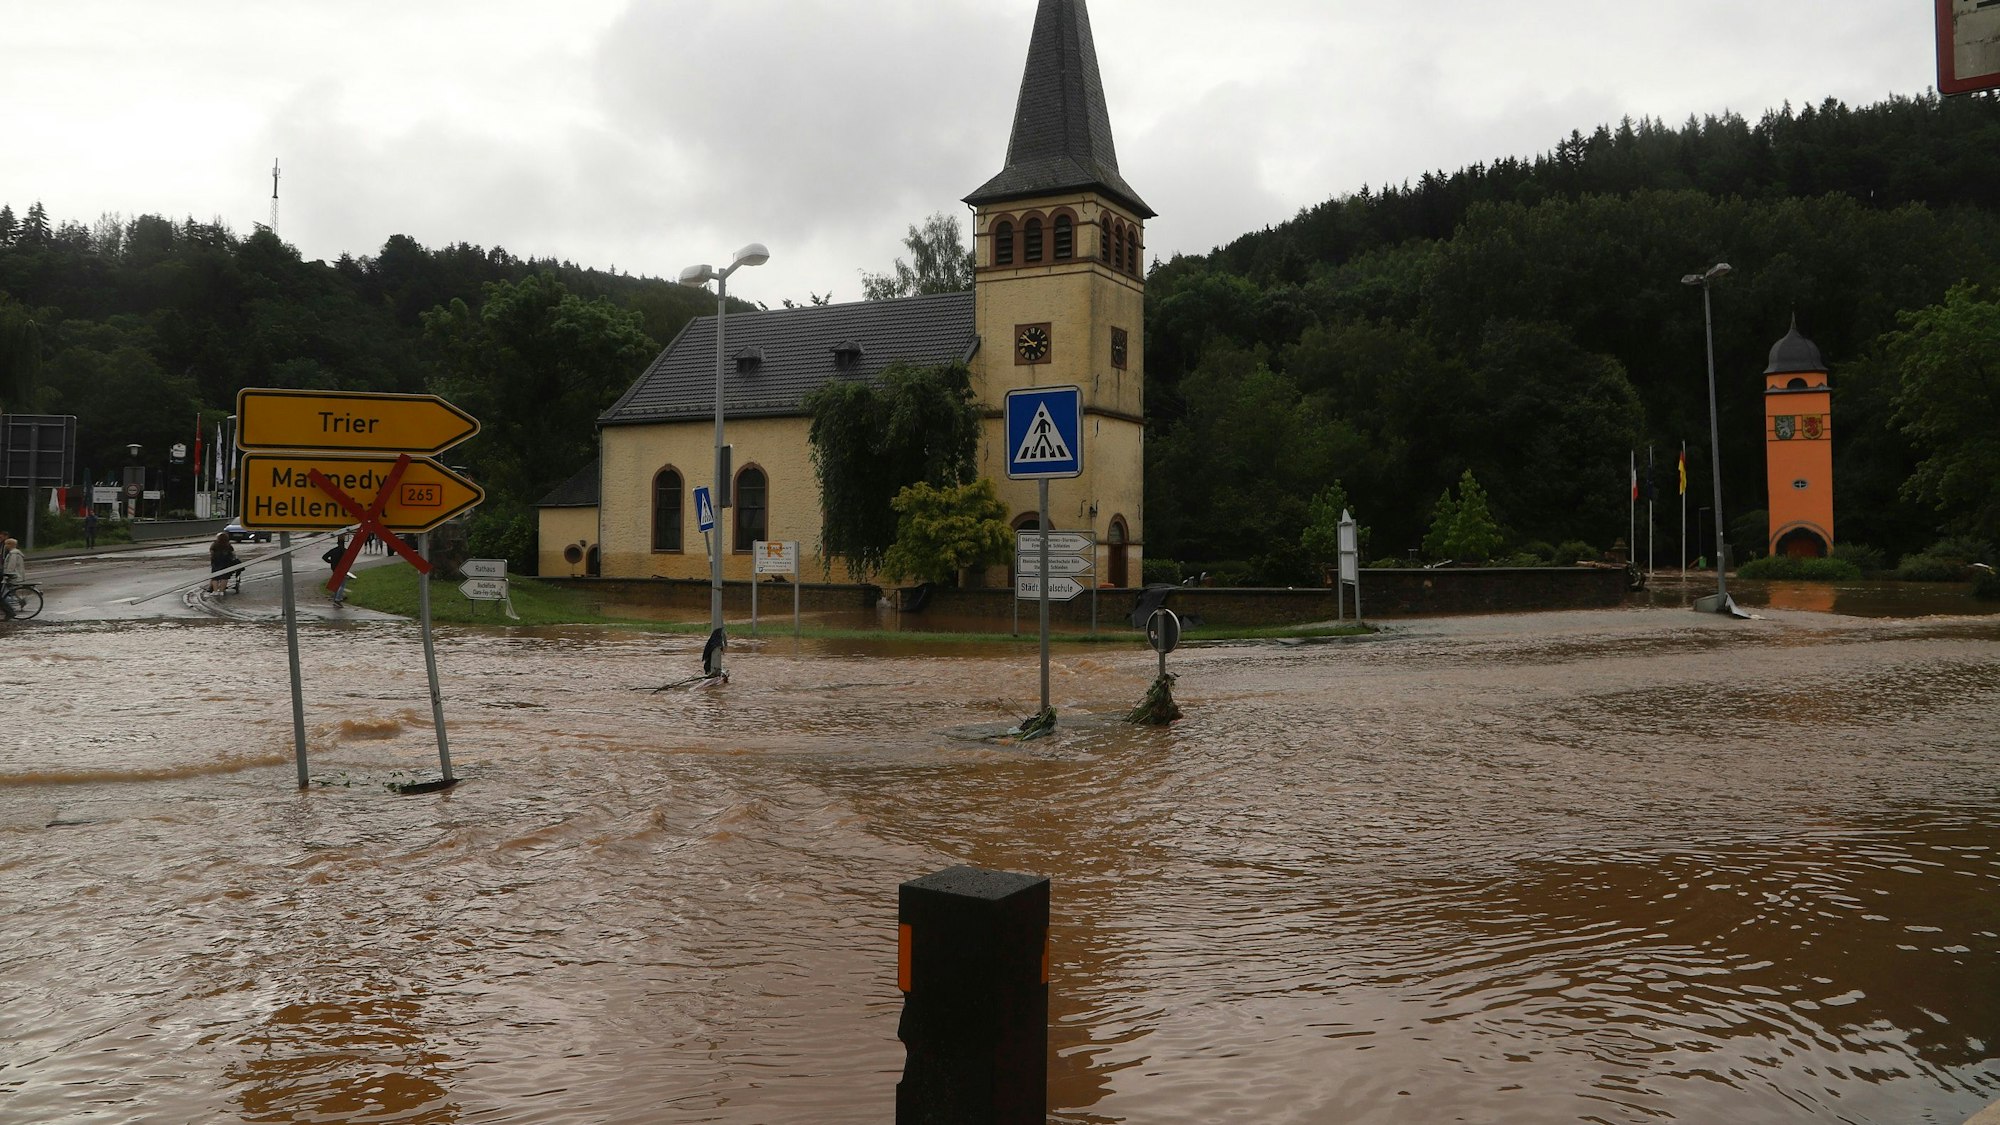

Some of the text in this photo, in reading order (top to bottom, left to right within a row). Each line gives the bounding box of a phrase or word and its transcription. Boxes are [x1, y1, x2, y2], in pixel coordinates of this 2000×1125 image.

[318, 412, 380, 433] Trier
[407, 488, 433, 501] 265
[475, 565, 496, 573] Rathaus
